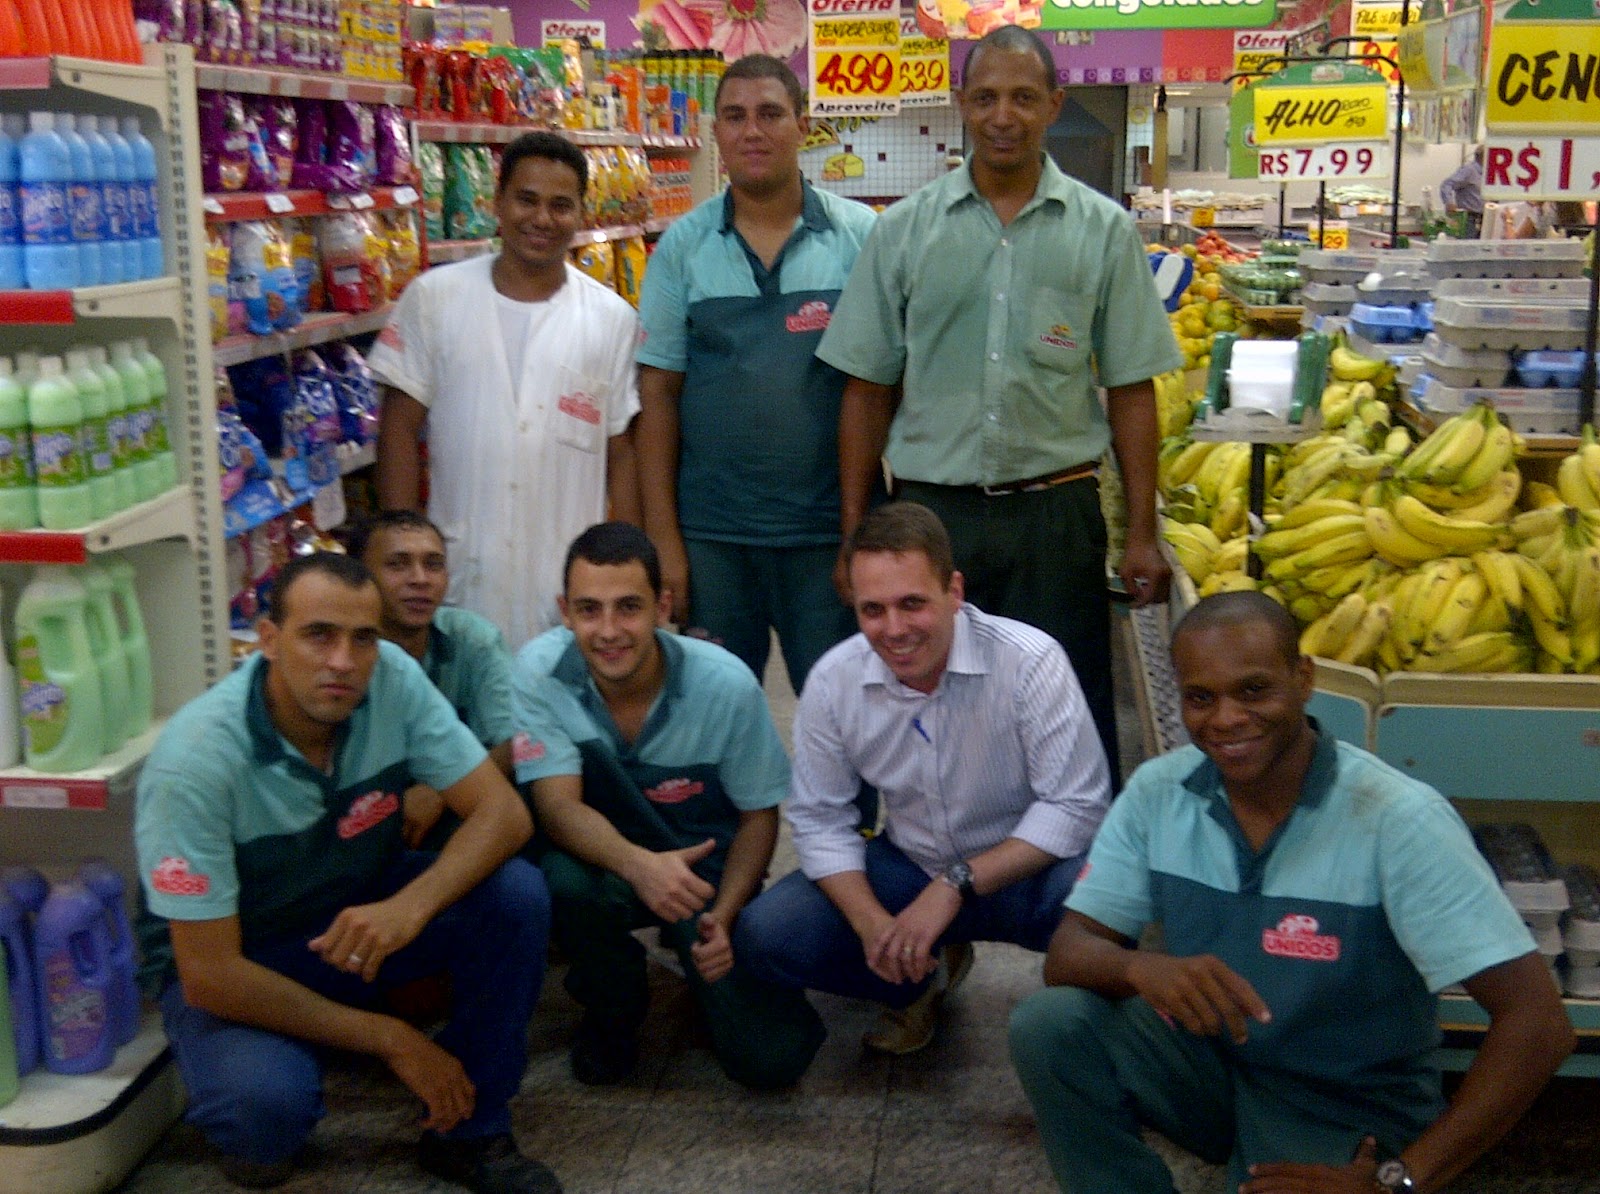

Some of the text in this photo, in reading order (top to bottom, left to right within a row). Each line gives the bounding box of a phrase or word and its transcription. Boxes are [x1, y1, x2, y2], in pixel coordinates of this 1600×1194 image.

[546, 23, 600, 36] Oferta
[1237, 33, 1288, 48] Ofert
[1497, 50, 1600, 107] CEN
[815, 102, 895, 113] Aproveite
[901, 96, 946, 105] proveite
[1264, 98, 1341, 135] ALHO
[1264, 937, 1336, 957] UNIDOS
